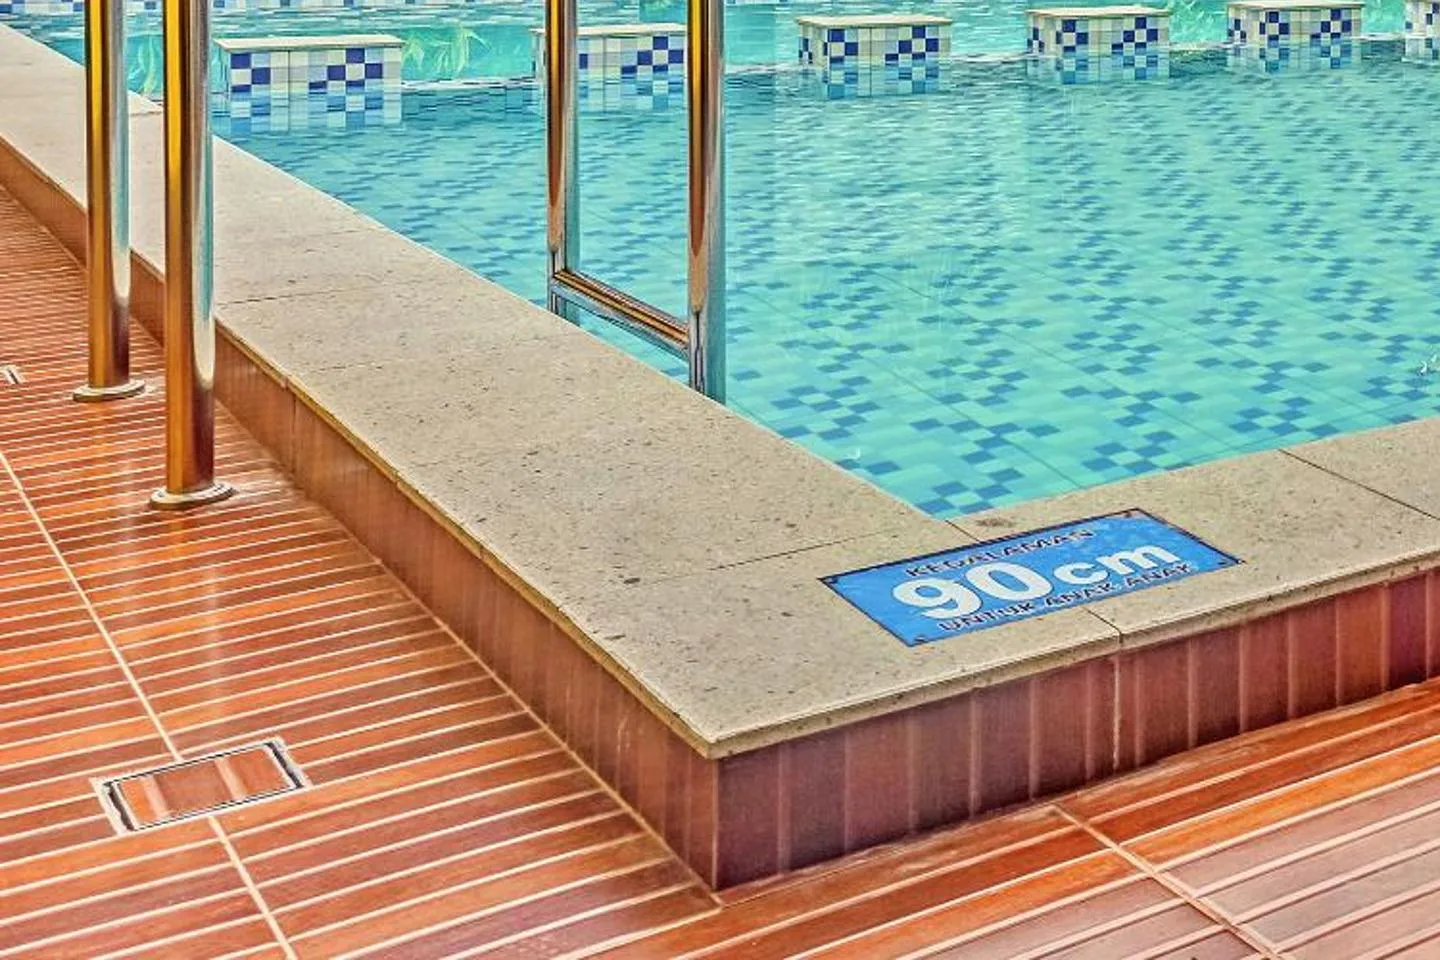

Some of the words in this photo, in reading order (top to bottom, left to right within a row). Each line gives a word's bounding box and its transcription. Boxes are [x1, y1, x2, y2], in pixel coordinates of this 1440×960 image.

[905, 529, 1095, 576] KEDALAMAN
[893, 561, 1052, 618] 90
[1053, 545, 1181, 584] cm
[938, 602, 1035, 631] UNTUK
